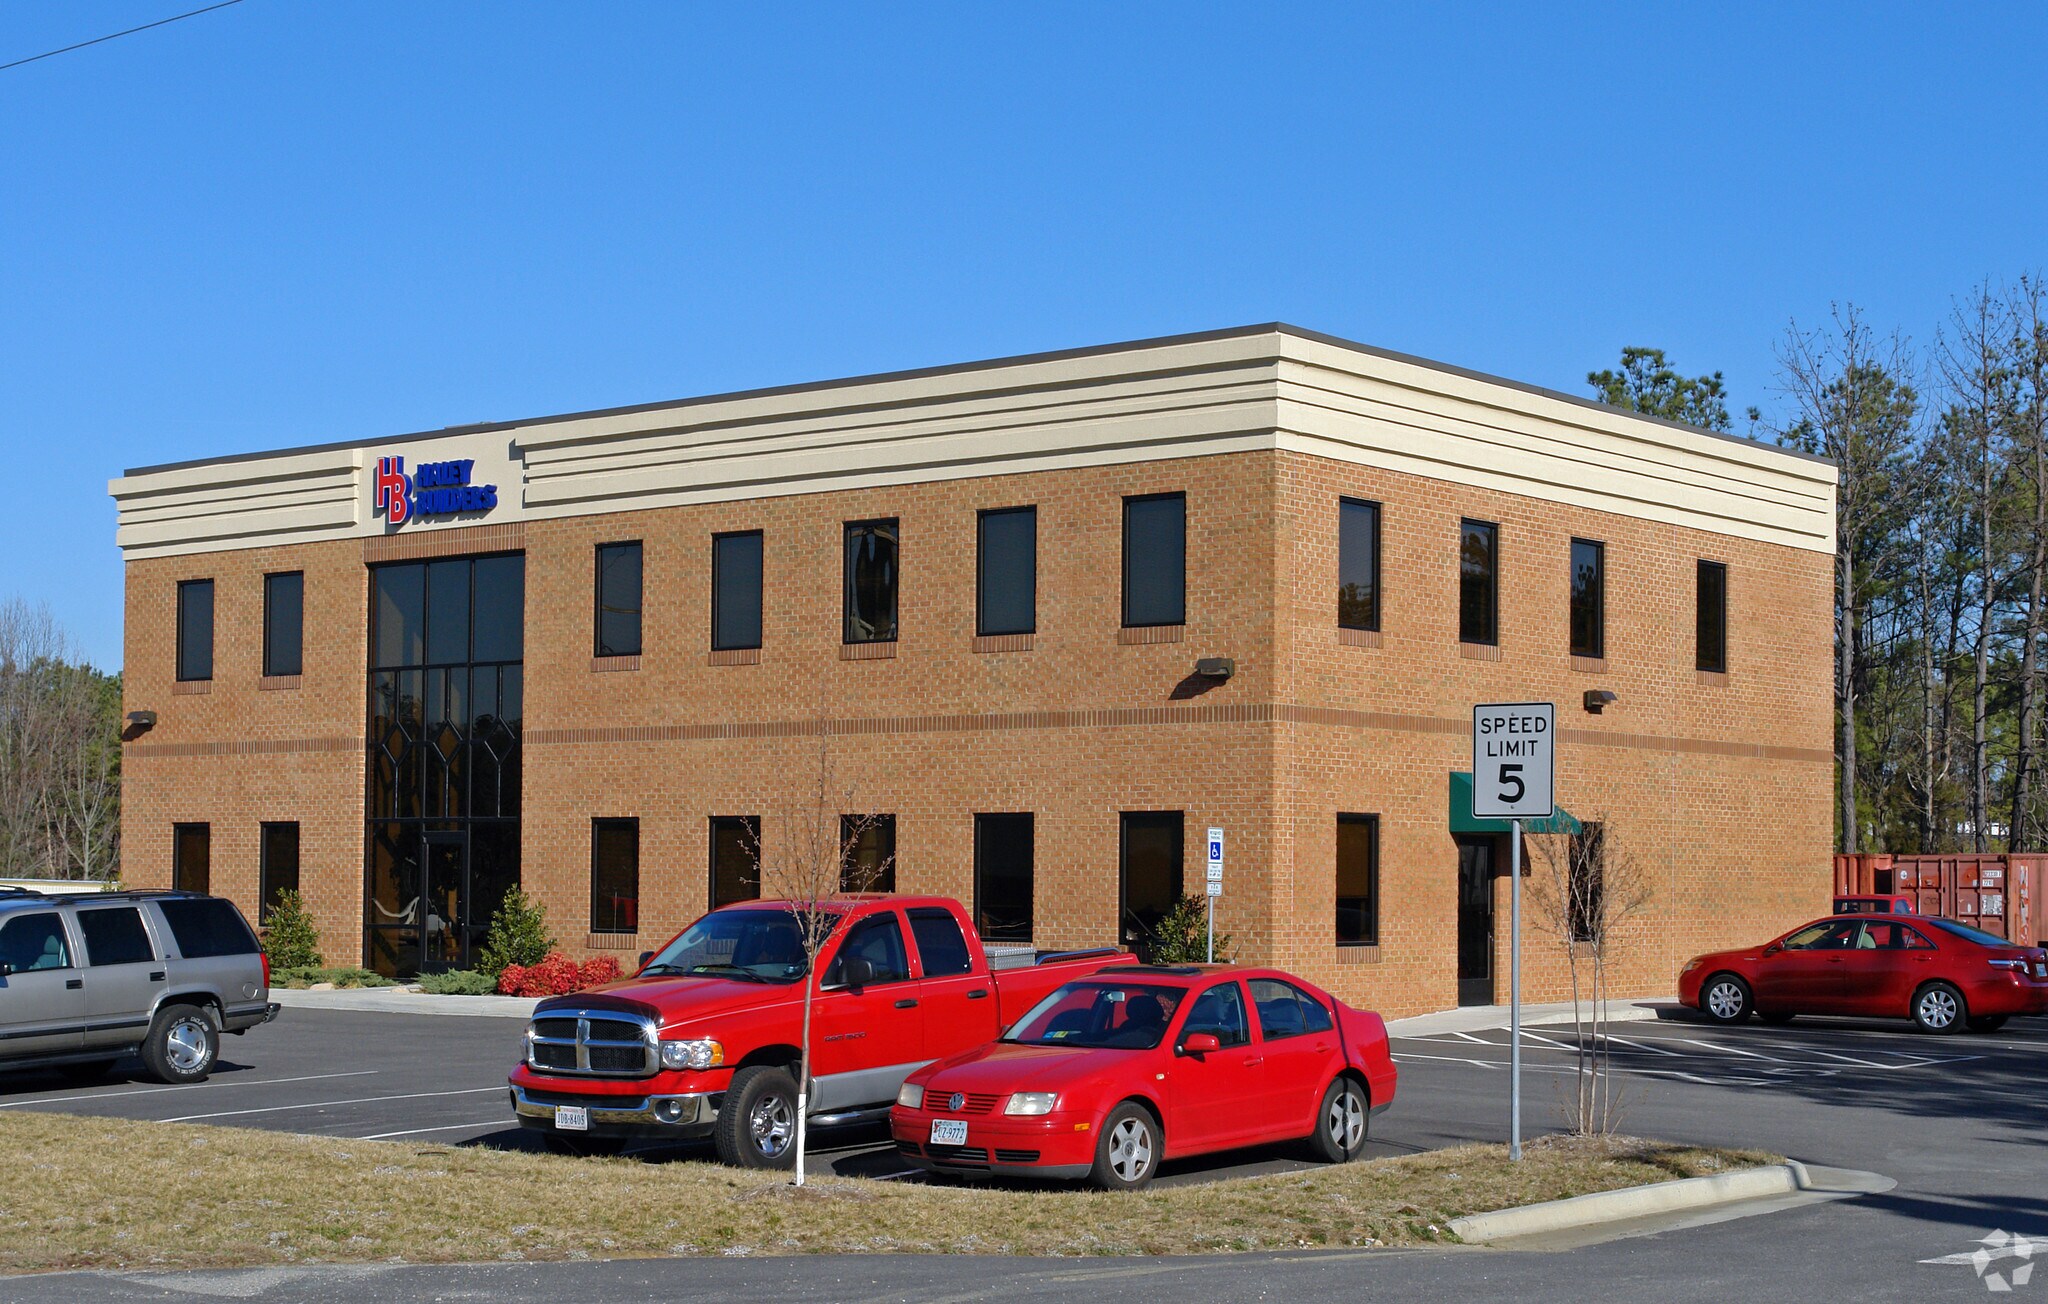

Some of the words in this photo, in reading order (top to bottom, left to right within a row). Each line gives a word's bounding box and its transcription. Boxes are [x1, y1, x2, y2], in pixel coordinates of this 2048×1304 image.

[416, 459, 475, 488] HALEY
[416, 484, 498, 515] BUILDERS
[1481, 717, 1547, 734] SPEED
[1487, 740, 1538, 757] LIMIT
[1498, 764, 1525, 803] 5
